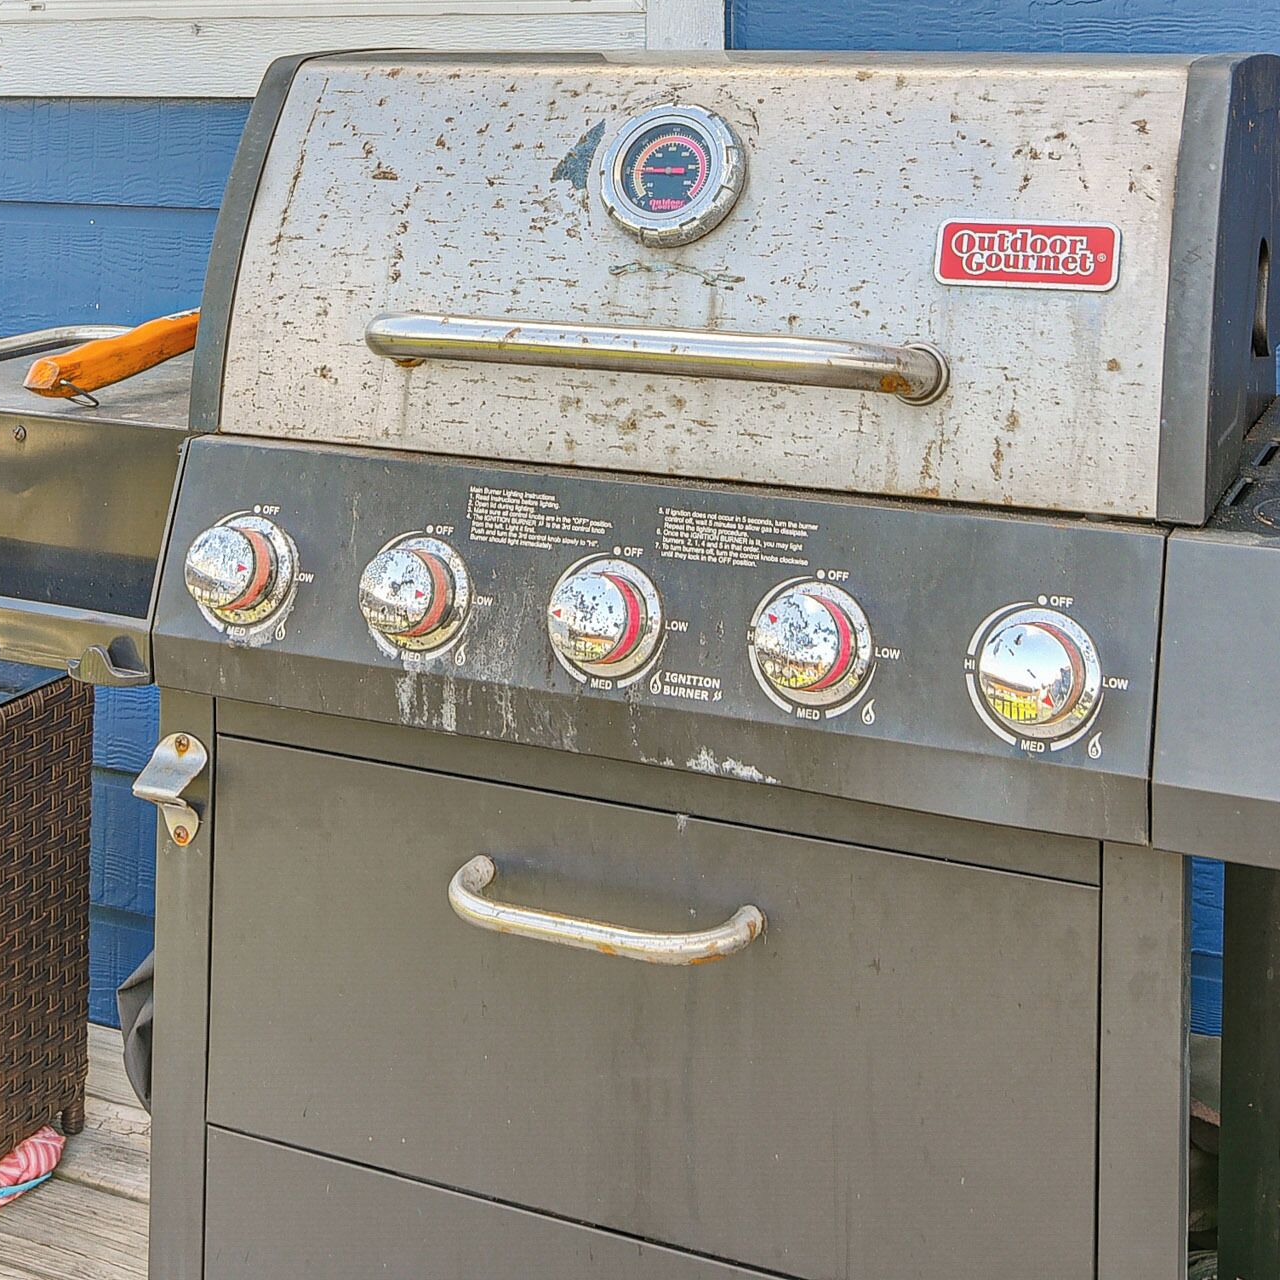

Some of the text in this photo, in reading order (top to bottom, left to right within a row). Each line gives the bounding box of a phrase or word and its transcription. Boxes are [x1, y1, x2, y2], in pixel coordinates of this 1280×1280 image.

[952, 229, 1087, 256] Outdoor
[962, 250, 1095, 276] Gourmet
[484, 487, 502, 495] Burner
[503, 489, 524, 499] Lighting
[263, 505, 280, 514] OFF
[475, 500, 489, 508] Open
[511, 518, 537, 526] BURNER
[692, 511, 706, 519] does
[775, 519, 786, 527] turn
[798, 522, 819, 530] burner
[436, 526, 454, 535] OFF
[505, 524, 519, 532] Light
[664, 522, 685, 531] Repeat
[713, 521, 737, 529] minutes
[745, 524, 760, 532] allow
[507, 538, 519, 546] light
[663, 529, 679, 537] Once
[720, 535, 747, 544] BURNER
[776, 543, 789, 551] may
[790, 543, 803, 551] light
[624, 547, 643, 558] OFF
[670, 544, 681, 552] turn
[682, 545, 704, 554] burners
[716, 549, 728, 557] turn
[729, 550, 738, 558] the
[761, 554, 778, 562] knobs
[779, 556, 808, 566] clockwise
[718, 556, 731, 564] OFF
[294, 572, 314, 583] LOW
[828, 571, 849, 582] OFF
[472, 596, 493, 606] LOW
[1050, 596, 1074, 608] OFF
[227, 626, 245, 636] MED
[665, 620, 688, 632] LOW
[747, 632, 754, 640] H
[401, 651, 420, 661] MED
[875, 648, 900, 660] LOW
[964, 659, 975, 670] HI
[591, 678, 612, 690] MED
[664, 672, 720, 688] IGNITION
[1103, 677, 1128, 690] LOW
[663, 686, 709, 700] BURNER
[797, 709, 820, 720] MED
[1021, 741, 1045, 752] MED
